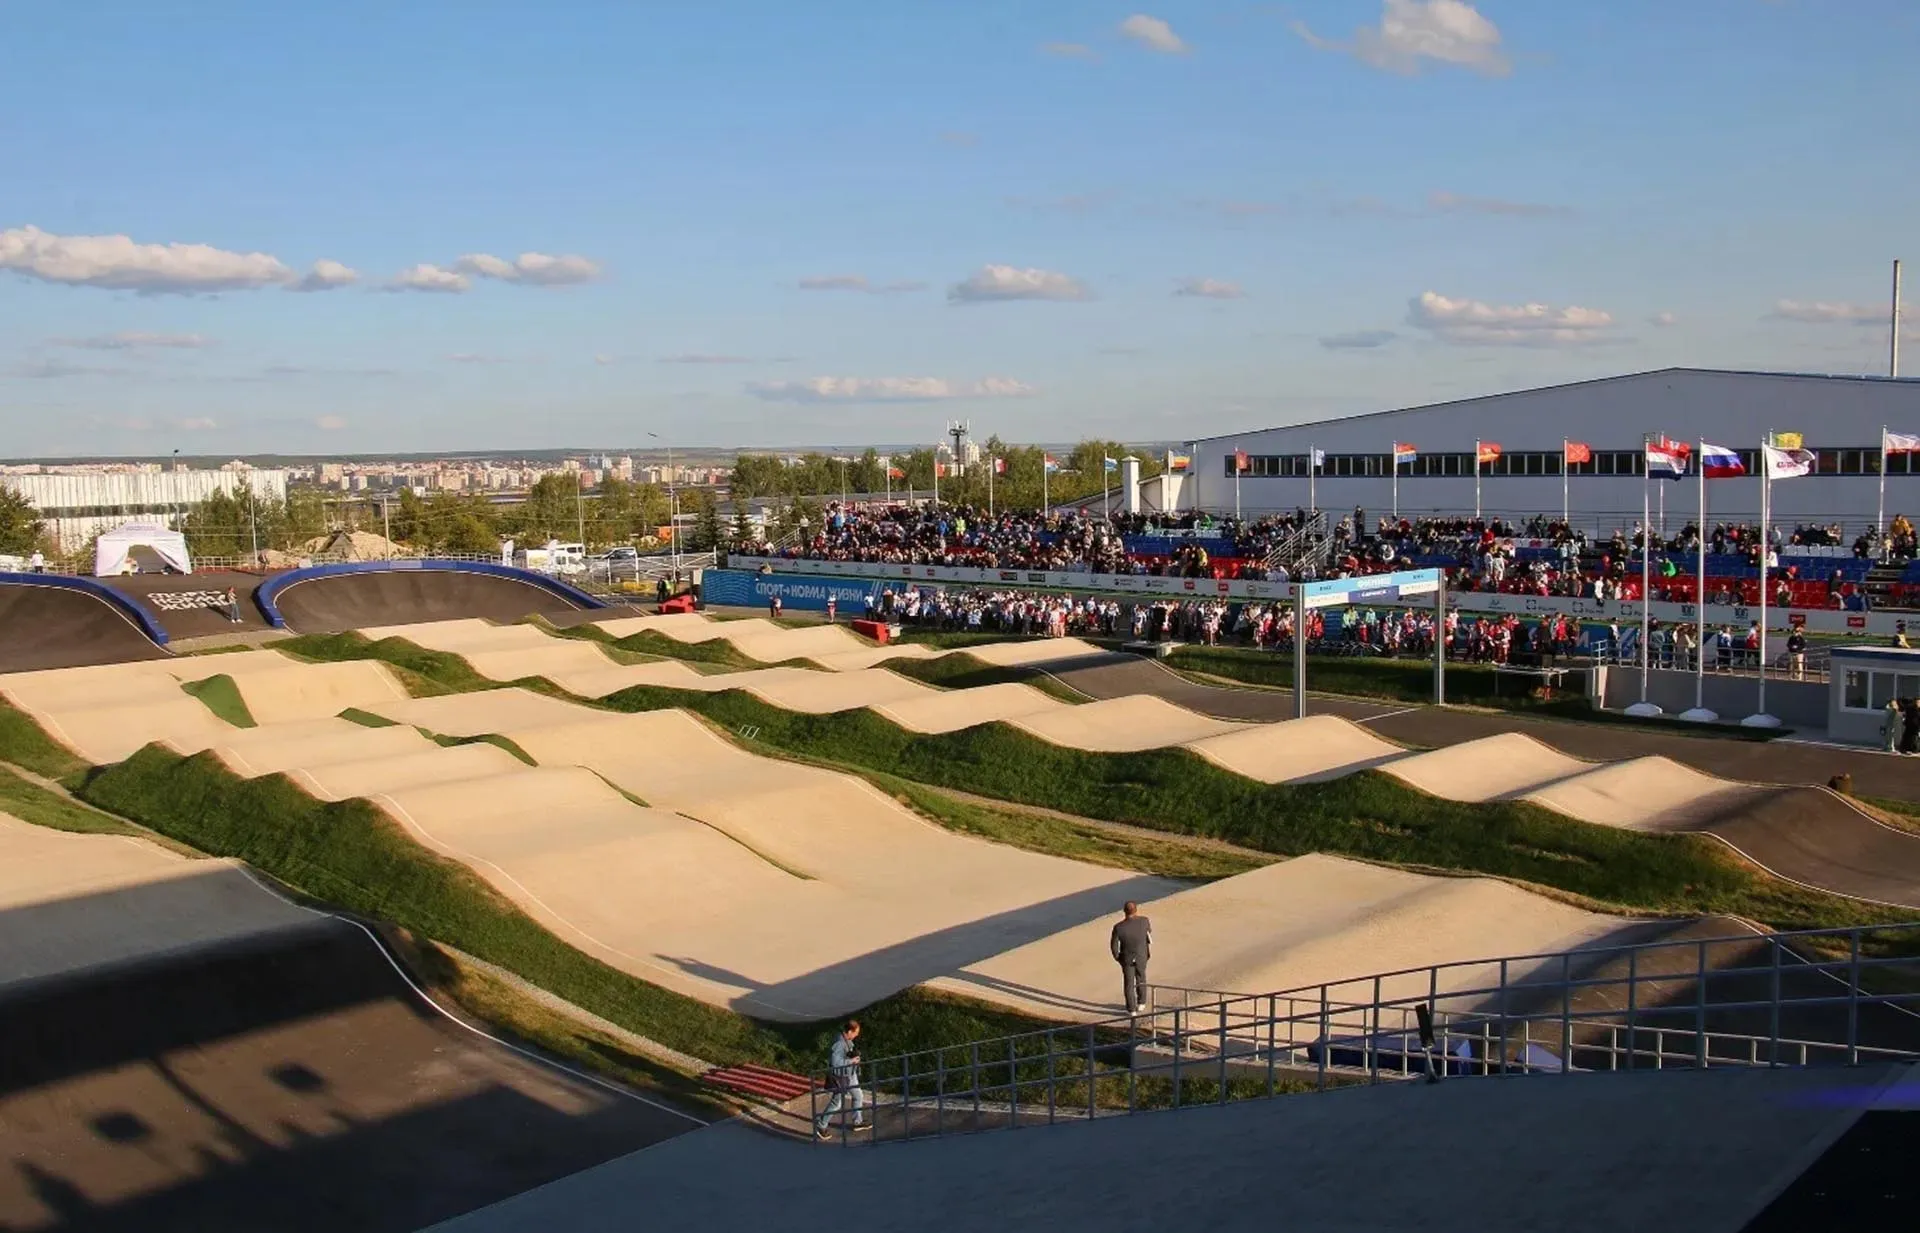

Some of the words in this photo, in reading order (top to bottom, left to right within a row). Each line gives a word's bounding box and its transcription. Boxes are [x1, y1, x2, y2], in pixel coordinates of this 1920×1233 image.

[756, 582, 784, 596] СПОРТ
[791, 585, 826, 600] НОРМА
[828, 587, 863, 602] ЖИЗНИ
